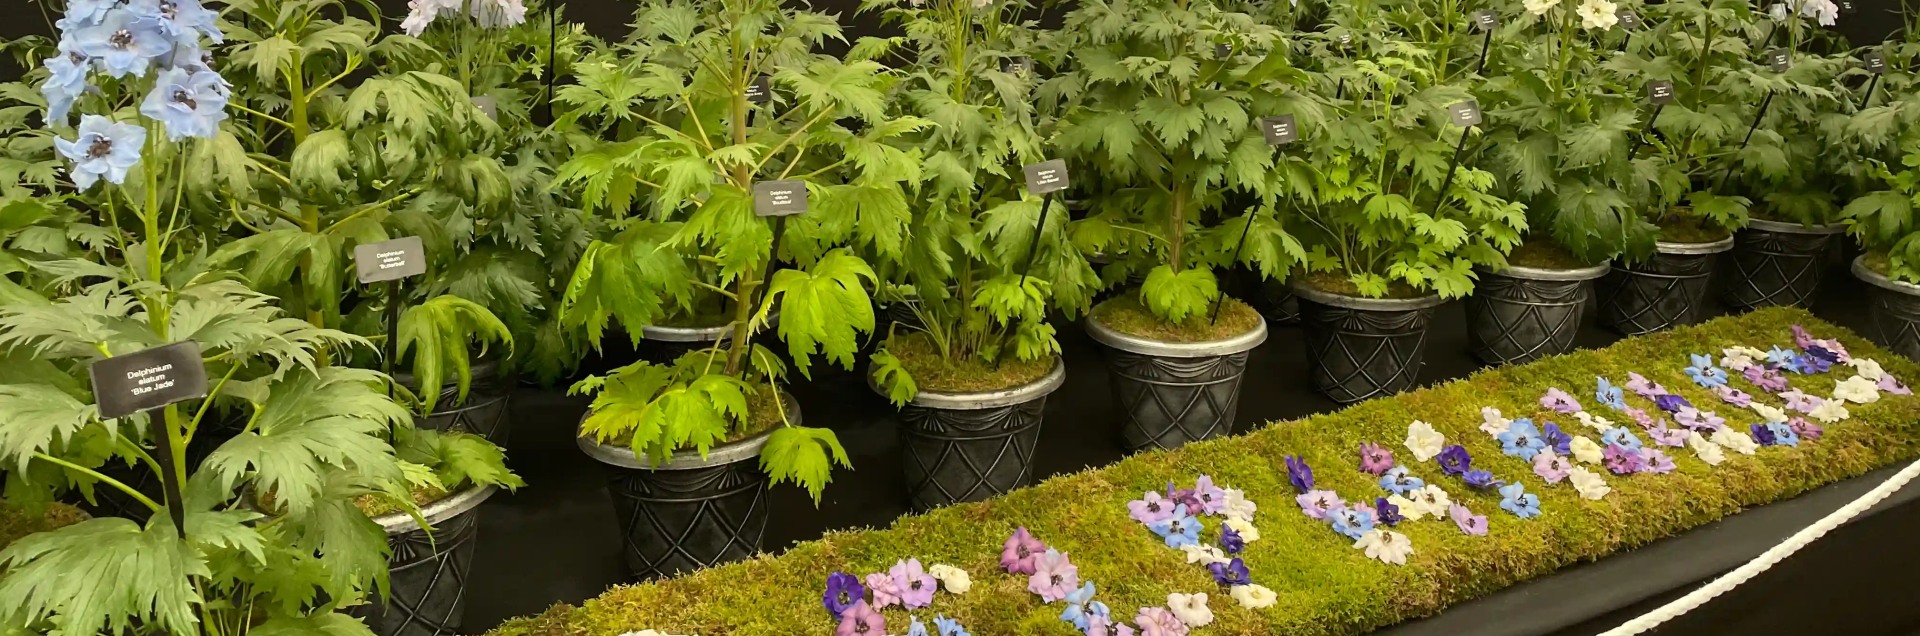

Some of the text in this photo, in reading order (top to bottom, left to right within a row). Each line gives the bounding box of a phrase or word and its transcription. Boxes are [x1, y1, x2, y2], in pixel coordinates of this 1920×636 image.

[376, 250, 405, 259] Delphinium
[127, 363, 173, 380] Delphinium
[138, 374, 165, 386] elatum
